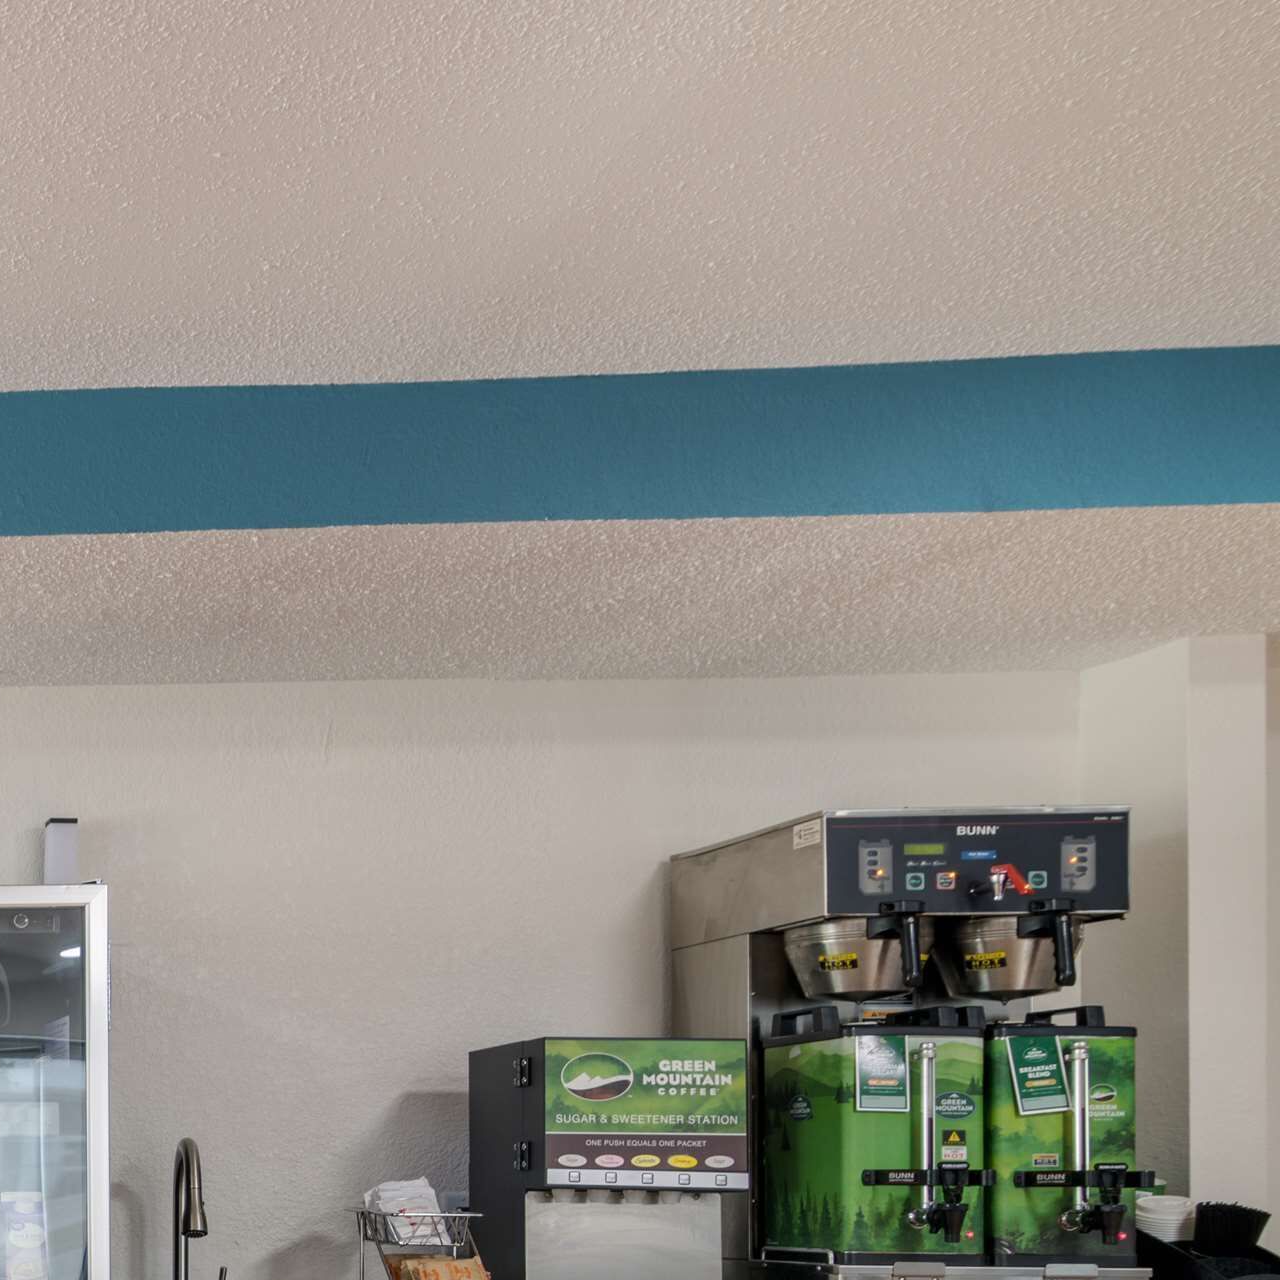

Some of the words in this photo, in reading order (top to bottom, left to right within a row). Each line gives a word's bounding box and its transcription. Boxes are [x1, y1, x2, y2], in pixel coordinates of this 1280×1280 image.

[956, 825, 996, 836] BUNN
[659, 1060, 716, 1071] GREEN
[1018, 1064, 1057, 1074] BREAKFAST
[642, 1073, 732, 1086] MOUNTAIN
[1028, 1070, 1051, 1079] BLEND
[657, 1087, 718, 1096] COFFEE
[555, 1114, 597, 1124] SUGAR
[600, 1114, 608, 1124] &
[611, 1115, 685, 1125] SWEETENER
[687, 1115, 739, 1125] STATION
[585, 1139, 602, 1147] ONE
[604, 1139, 625, 1147] PUSH
